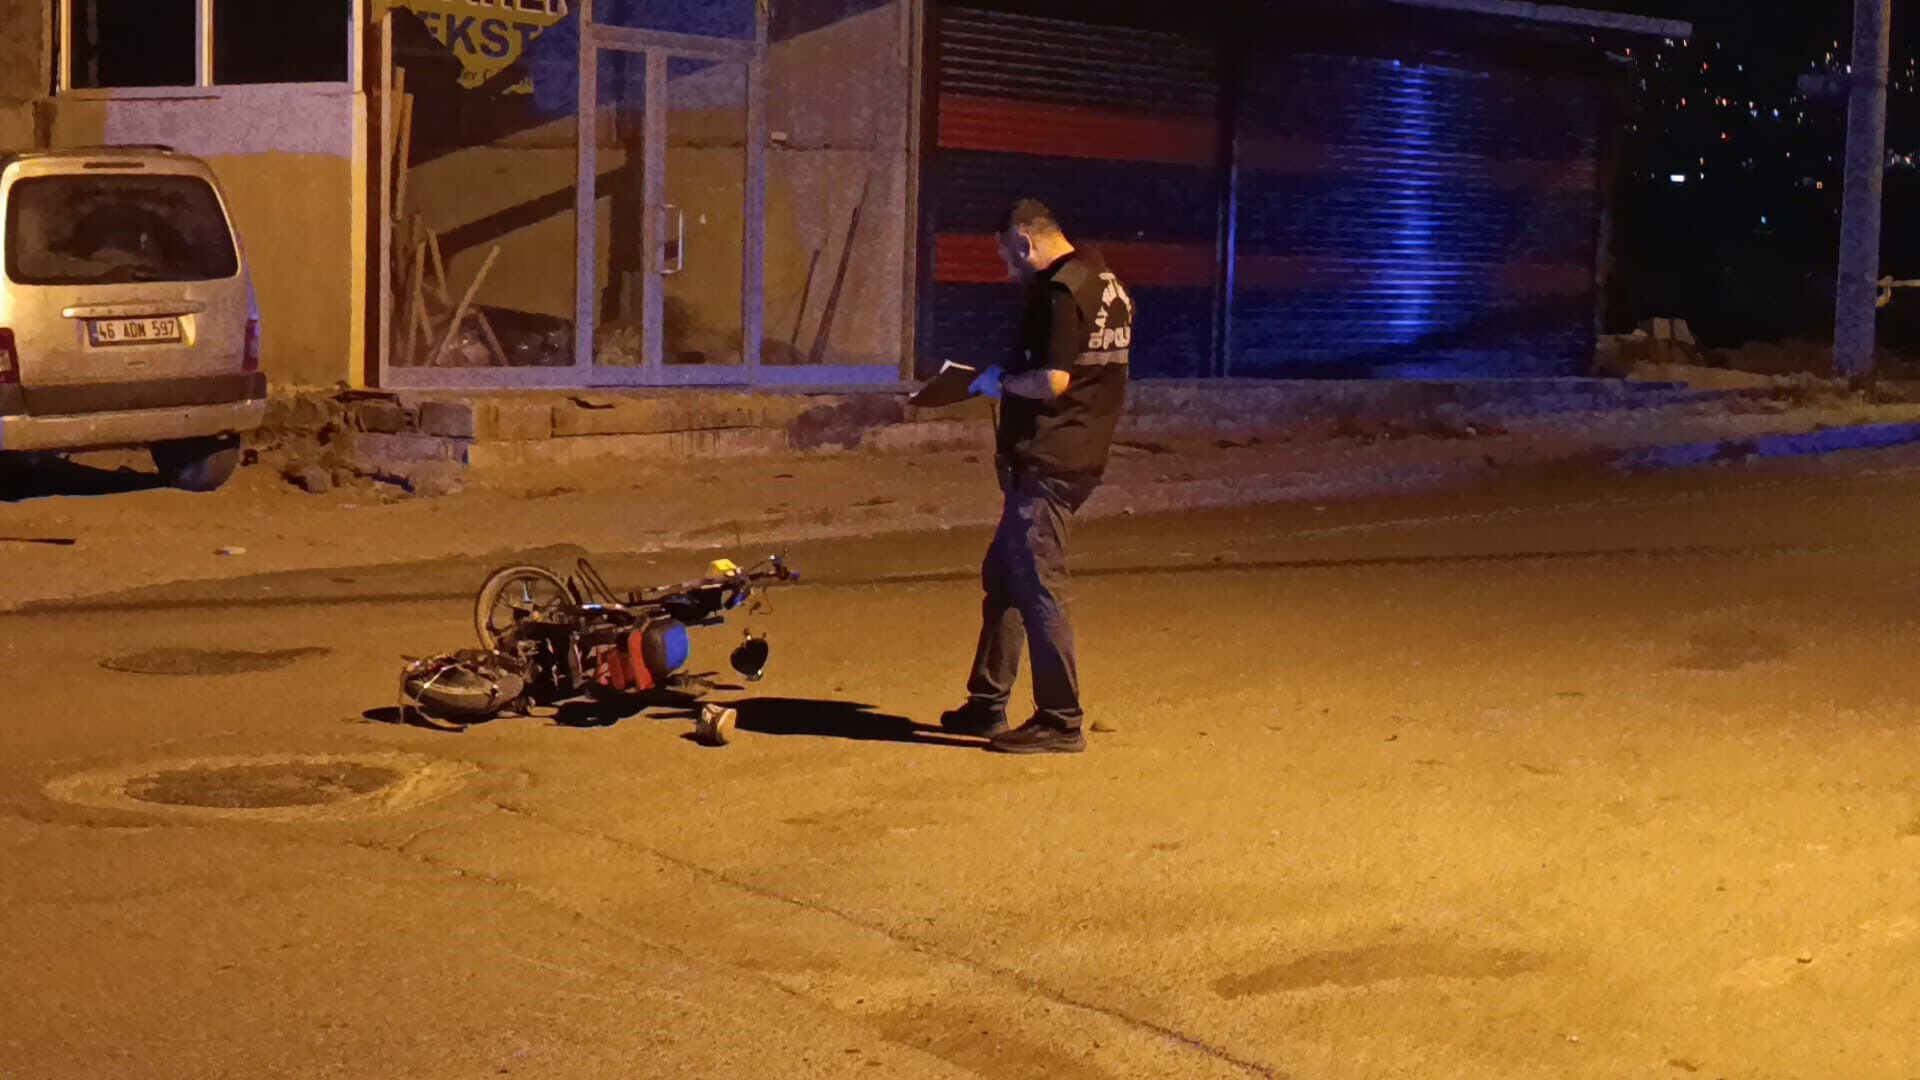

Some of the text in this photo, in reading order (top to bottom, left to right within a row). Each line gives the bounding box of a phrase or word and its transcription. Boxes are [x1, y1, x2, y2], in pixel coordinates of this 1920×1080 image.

[99, 318, 175, 340] 46 ADN 597
